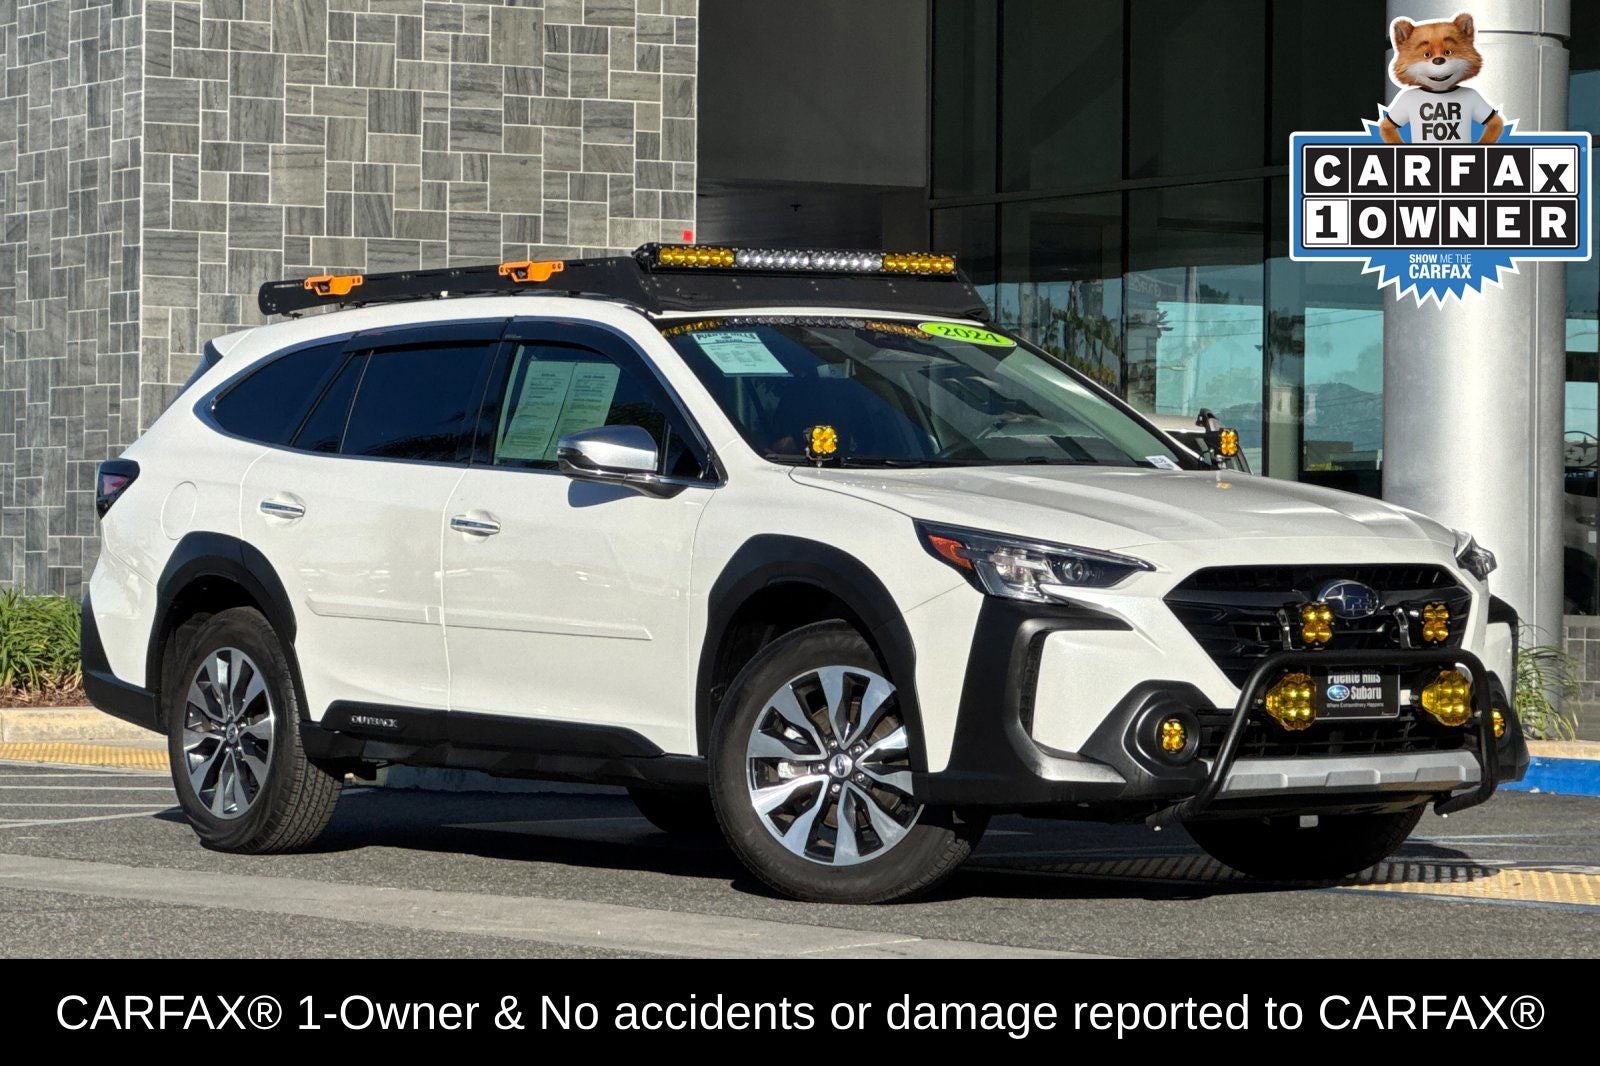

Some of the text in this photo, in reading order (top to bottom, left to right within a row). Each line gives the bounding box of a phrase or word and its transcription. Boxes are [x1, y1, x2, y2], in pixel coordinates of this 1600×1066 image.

[937, 326, 1002, 343] 2024
[1350, 685, 1383, 700] Subaru
[351, 715, 398, 728] OUTBACK
